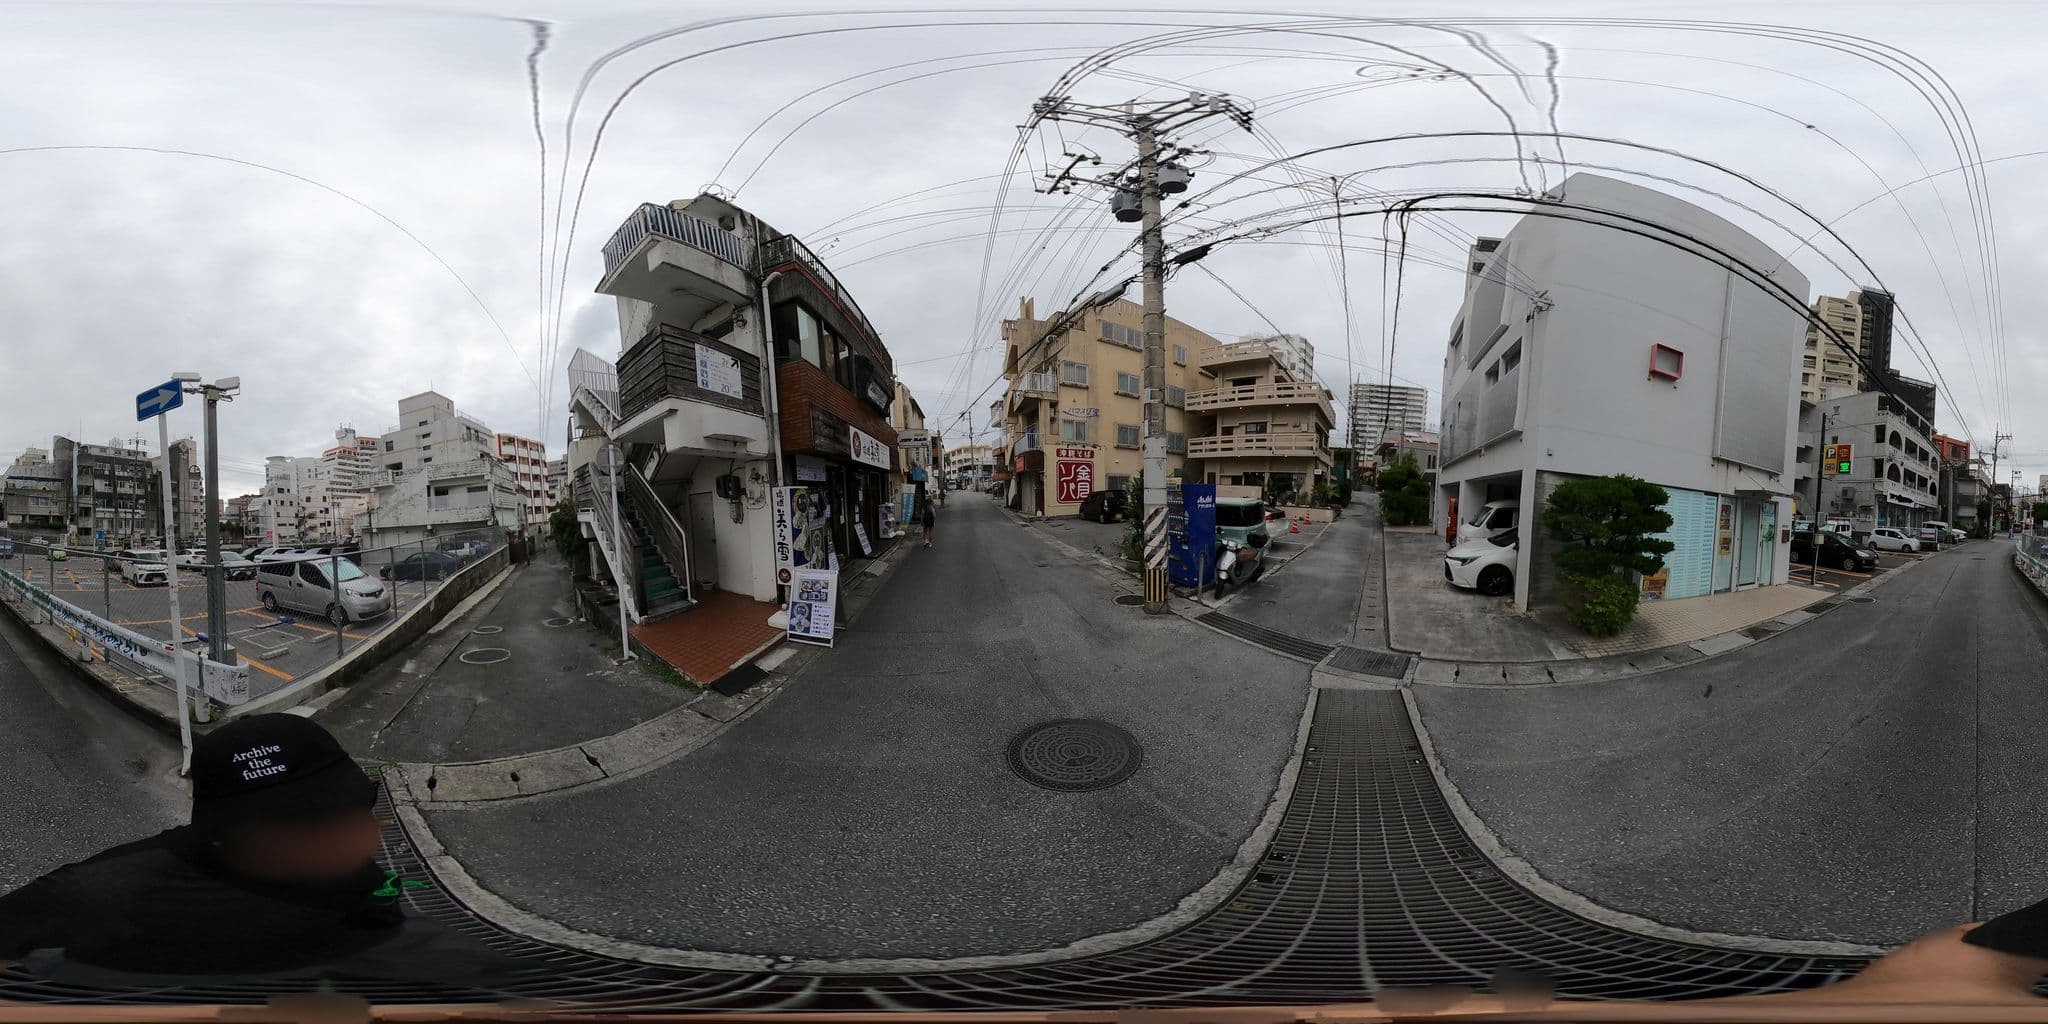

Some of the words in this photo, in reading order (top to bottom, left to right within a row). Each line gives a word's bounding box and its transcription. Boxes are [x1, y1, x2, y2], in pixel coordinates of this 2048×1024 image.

[1827, 448, 1836, 458] P
[776, 509, 790, 561] 美ら雪
[232, 745, 281, 762] Archive
[248, 758, 272, 769] the
[242, 764, 287, 780] future
